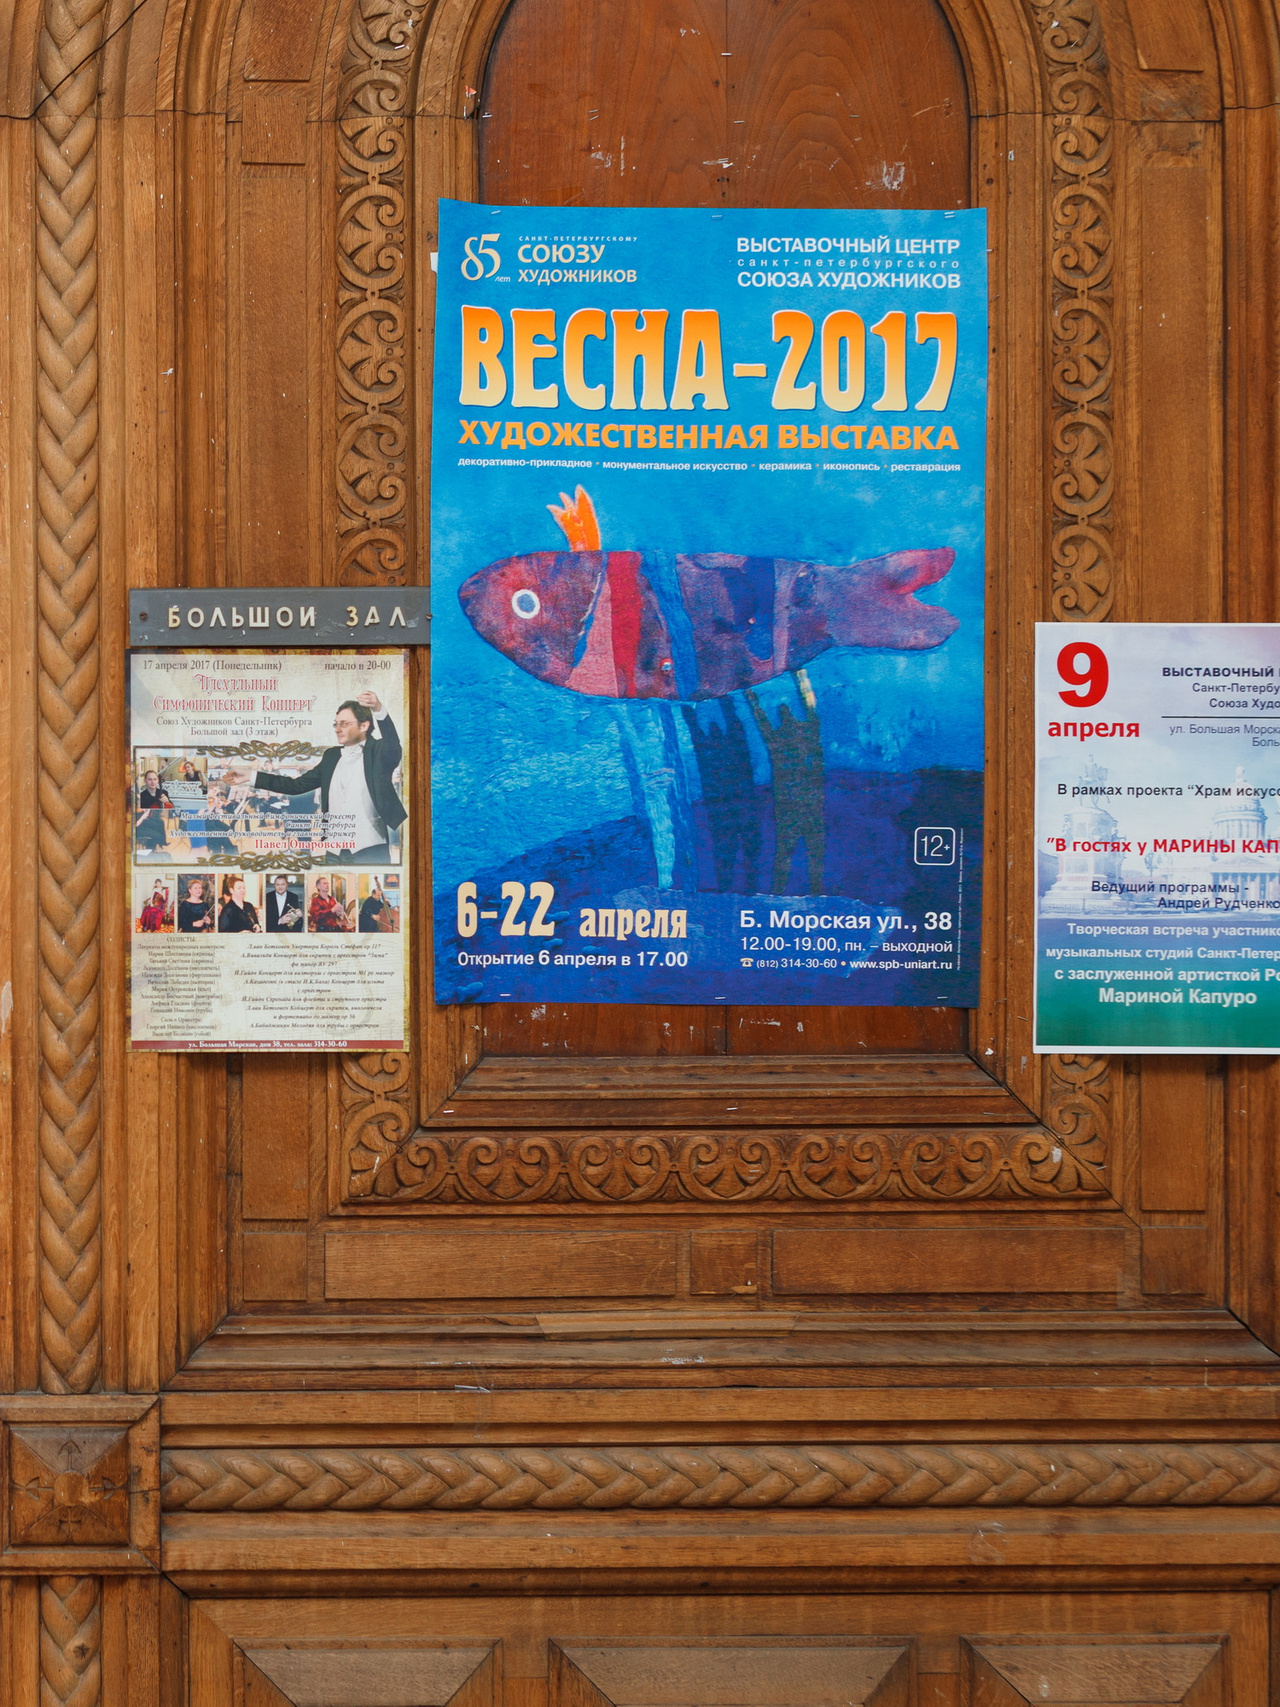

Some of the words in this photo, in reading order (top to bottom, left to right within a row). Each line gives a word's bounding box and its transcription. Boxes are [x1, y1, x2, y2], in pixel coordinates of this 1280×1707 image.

[736, 235, 890, 253] ВЫСТАВОЧНЫЙ
[895, 239, 960, 256] ЦЕНТР
[460, 233, 501, 281] 85
[517, 244, 606, 263] СОЮЗУ
[737, 258, 960, 269] санкт-петербургского
[495, 275, 511, 283] лет
[517, 269, 638, 286] ХУДОЖНИКОВ
[736, 271, 813, 288] СОЮЗА
[817, 272, 961, 290] ХУДОЖНИКОВ
[458, 420, 768, 450] ХУДОЖЕСТВЕННАЯ
[778, 424, 960, 450] ВЫСТАВКА
[458, 457, 592, 468] декоративно-прикладное
[602, 460, 690, 471] монументальное
[692, 462, 748, 472] искусство
[759, 462, 812, 472] керамика
[823, 462, 880, 471] иконопись
[890, 463, 961, 473] реставрация
[346, 605, 407, 628] ЗАЛ
[143, 660, 153, 670] 17
[155, 662, 188, 673] апреля
[190, 660, 210, 670] 2017
[212, 660, 282, 672] (Понедельник)
[324, 662, 356, 670] начало
[366, 660, 391, 670] 20-00
[1162, 666, 1274, 677] ВЫСТАВОЧНЫЙ
[1056, 641, 1110, 708] 9
[1209, 698, 1248, 708] Союза
[156, 717, 179, 726] Союз
[181, 717, 232, 728] Художников
[234, 716, 313, 728] Санкт-Петербурга
[190, 727, 228, 736] Большой
[255, 727, 279, 737] этаж)
[1048, 721, 1140, 742] апреля
[1169, 725, 1186, 736] ул.
[1189, 724, 1240, 734] Большая
[1057, 784, 1067, 795] В
[1072, 785, 1122, 797] рамках
[1127, 786, 1183, 798] проекта
[255, 839, 287, 849] Павел
[920, 835, 951, 858] 12+
[1072, 840, 1132, 852] гостях
[1137, 841, 1147, 856] у
[1153, 839, 1235, 853] МАРИНЫ
[1091, 880, 1155, 895] Ведущий
[1159, 883, 1240, 895] программы
[457, 881, 556, 938] 6-22
[579, 908, 688, 941] апреля
[1157, 897, 1210, 910] Андрей
[1214, 897, 1280, 911] Рудченко
[740, 909, 762, 928] Б.
[769, 910, 871, 932] Морская
[876, 915, 918, 933] ул.,
[924, 912, 953, 930] 38
[1067, 923, 1149, 937] Творческая
[1153, 925, 1209, 938] встреча
[740, 937, 841, 953] 12.00-19.00,
[844, 941, 866, 951] пн.
[882, 940, 953, 954] выходной
[457, 951, 535, 968] Открытие
[538, 950, 550, 966] 6
[553, 954, 617, 969] апреля
[621, 954, 632, 966] в
[636, 951, 689, 967] 17.00
[1046, 948, 1142, 960] музыкальных
[1145, 947, 1194, 960] студий
[756, 960, 779, 969] (812)
[780, 958, 838, 969] 314-30-60
[849, 958, 953, 972] www.spb-uniart.ru
[1054, 969, 1064, 980] с
[1068, 968, 1173, 983] заслуженной
[1177, 968, 1261, 983] артисткой
[1099, 987, 1183, 1006] Мариной
[1189, 989, 1258, 1007] Капуро
[313, 1040, 348, 1048] 314-30-60
